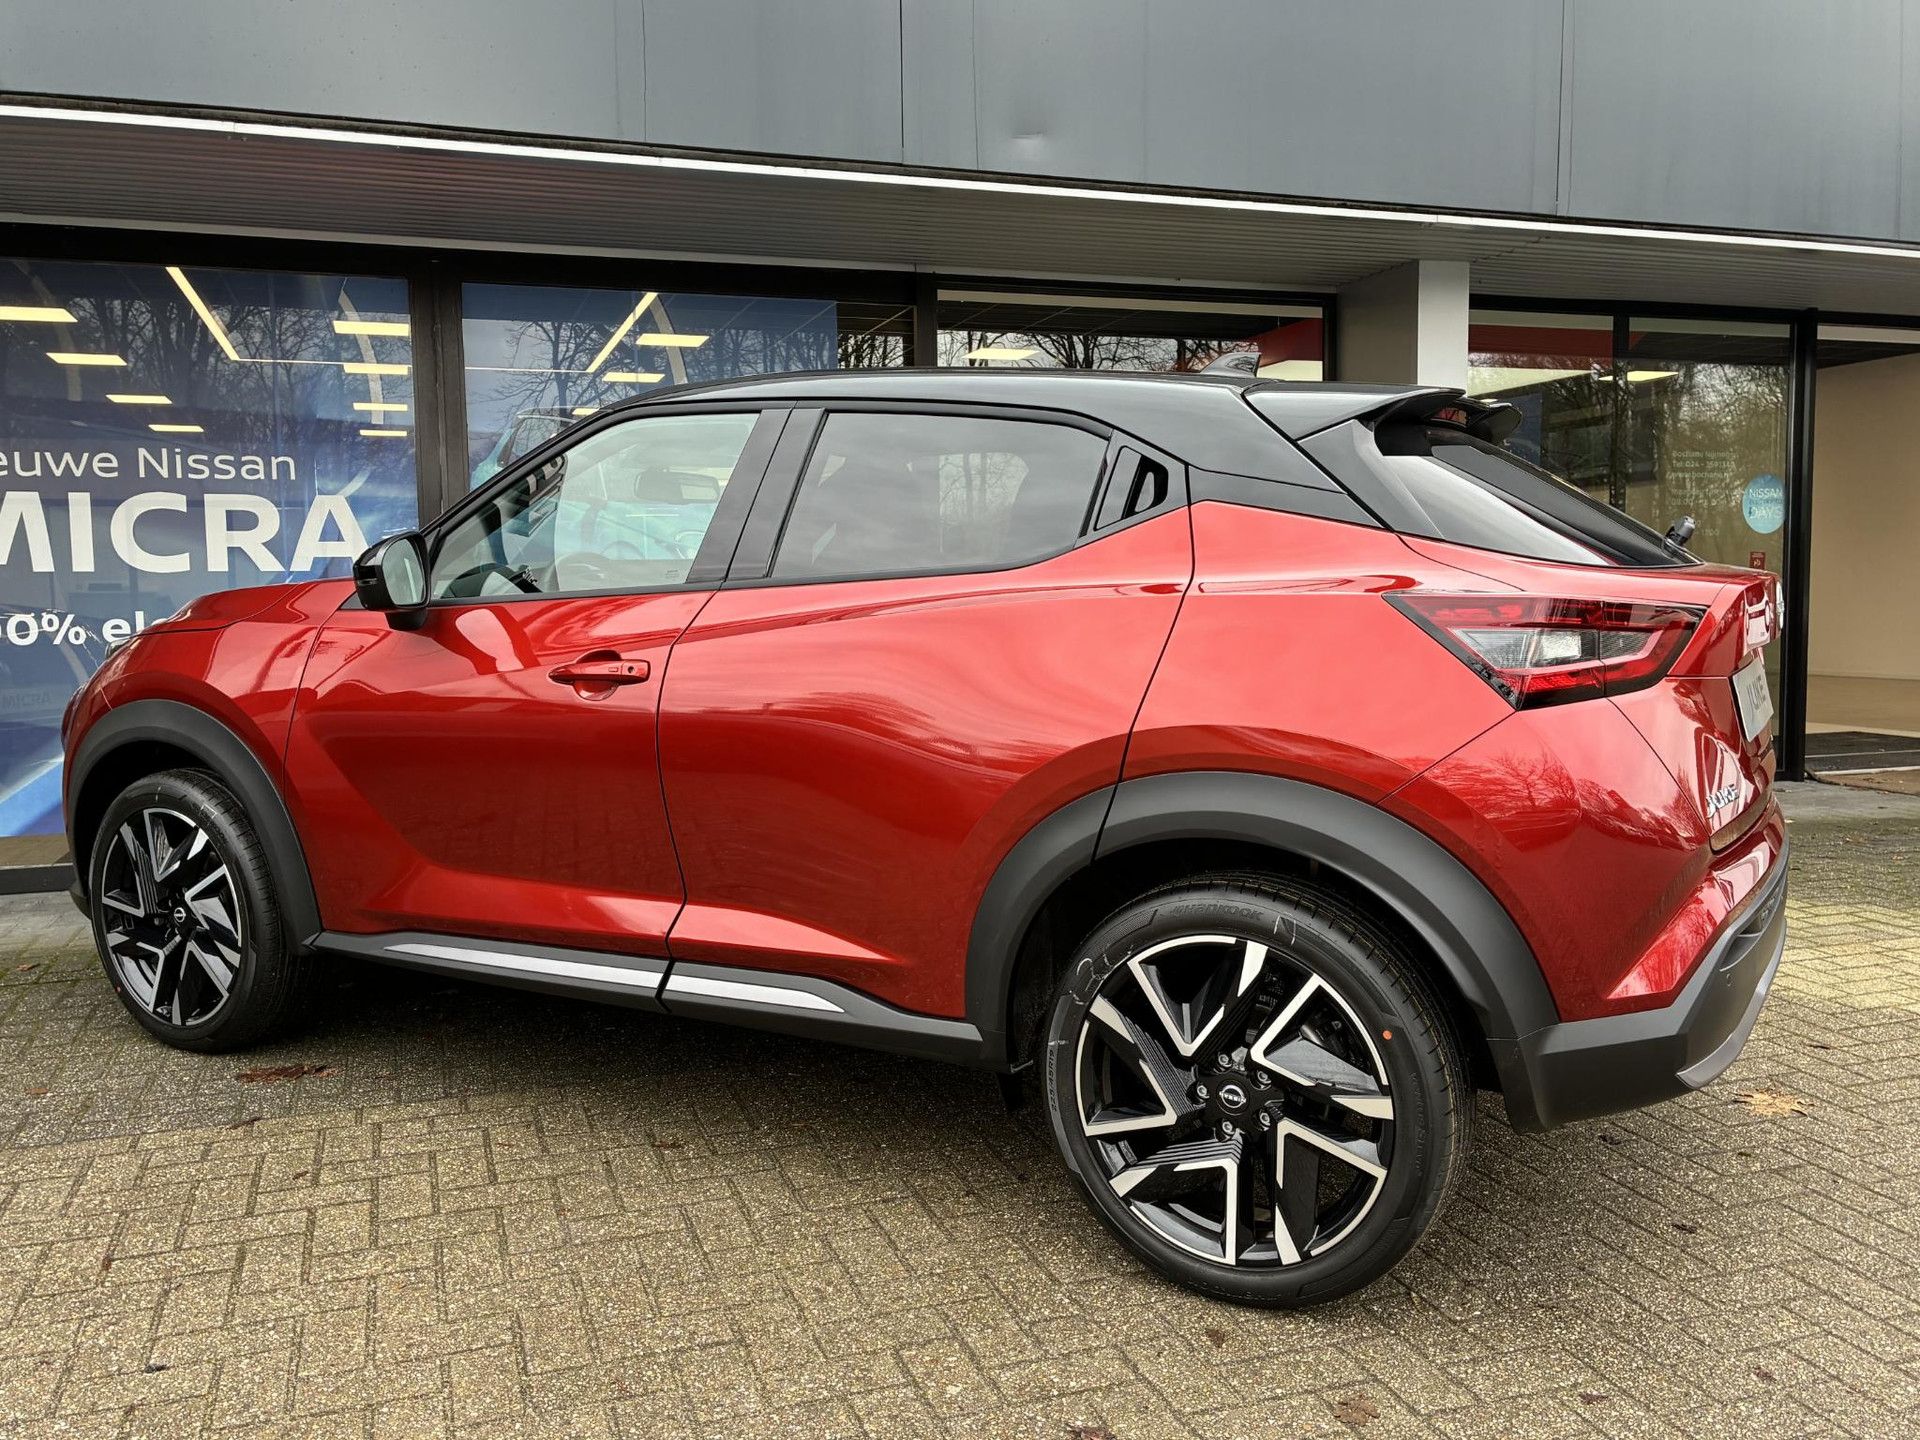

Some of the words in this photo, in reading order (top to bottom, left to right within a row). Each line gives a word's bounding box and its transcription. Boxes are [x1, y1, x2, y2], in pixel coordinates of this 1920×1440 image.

[138, 447, 296, 481] Nissan
[1749, 487, 1783, 499] NISSAN
[0, 613, 86, 646] 0%
[102, 611, 167, 643] el
[1706, 784, 1739, 818] JUKE
